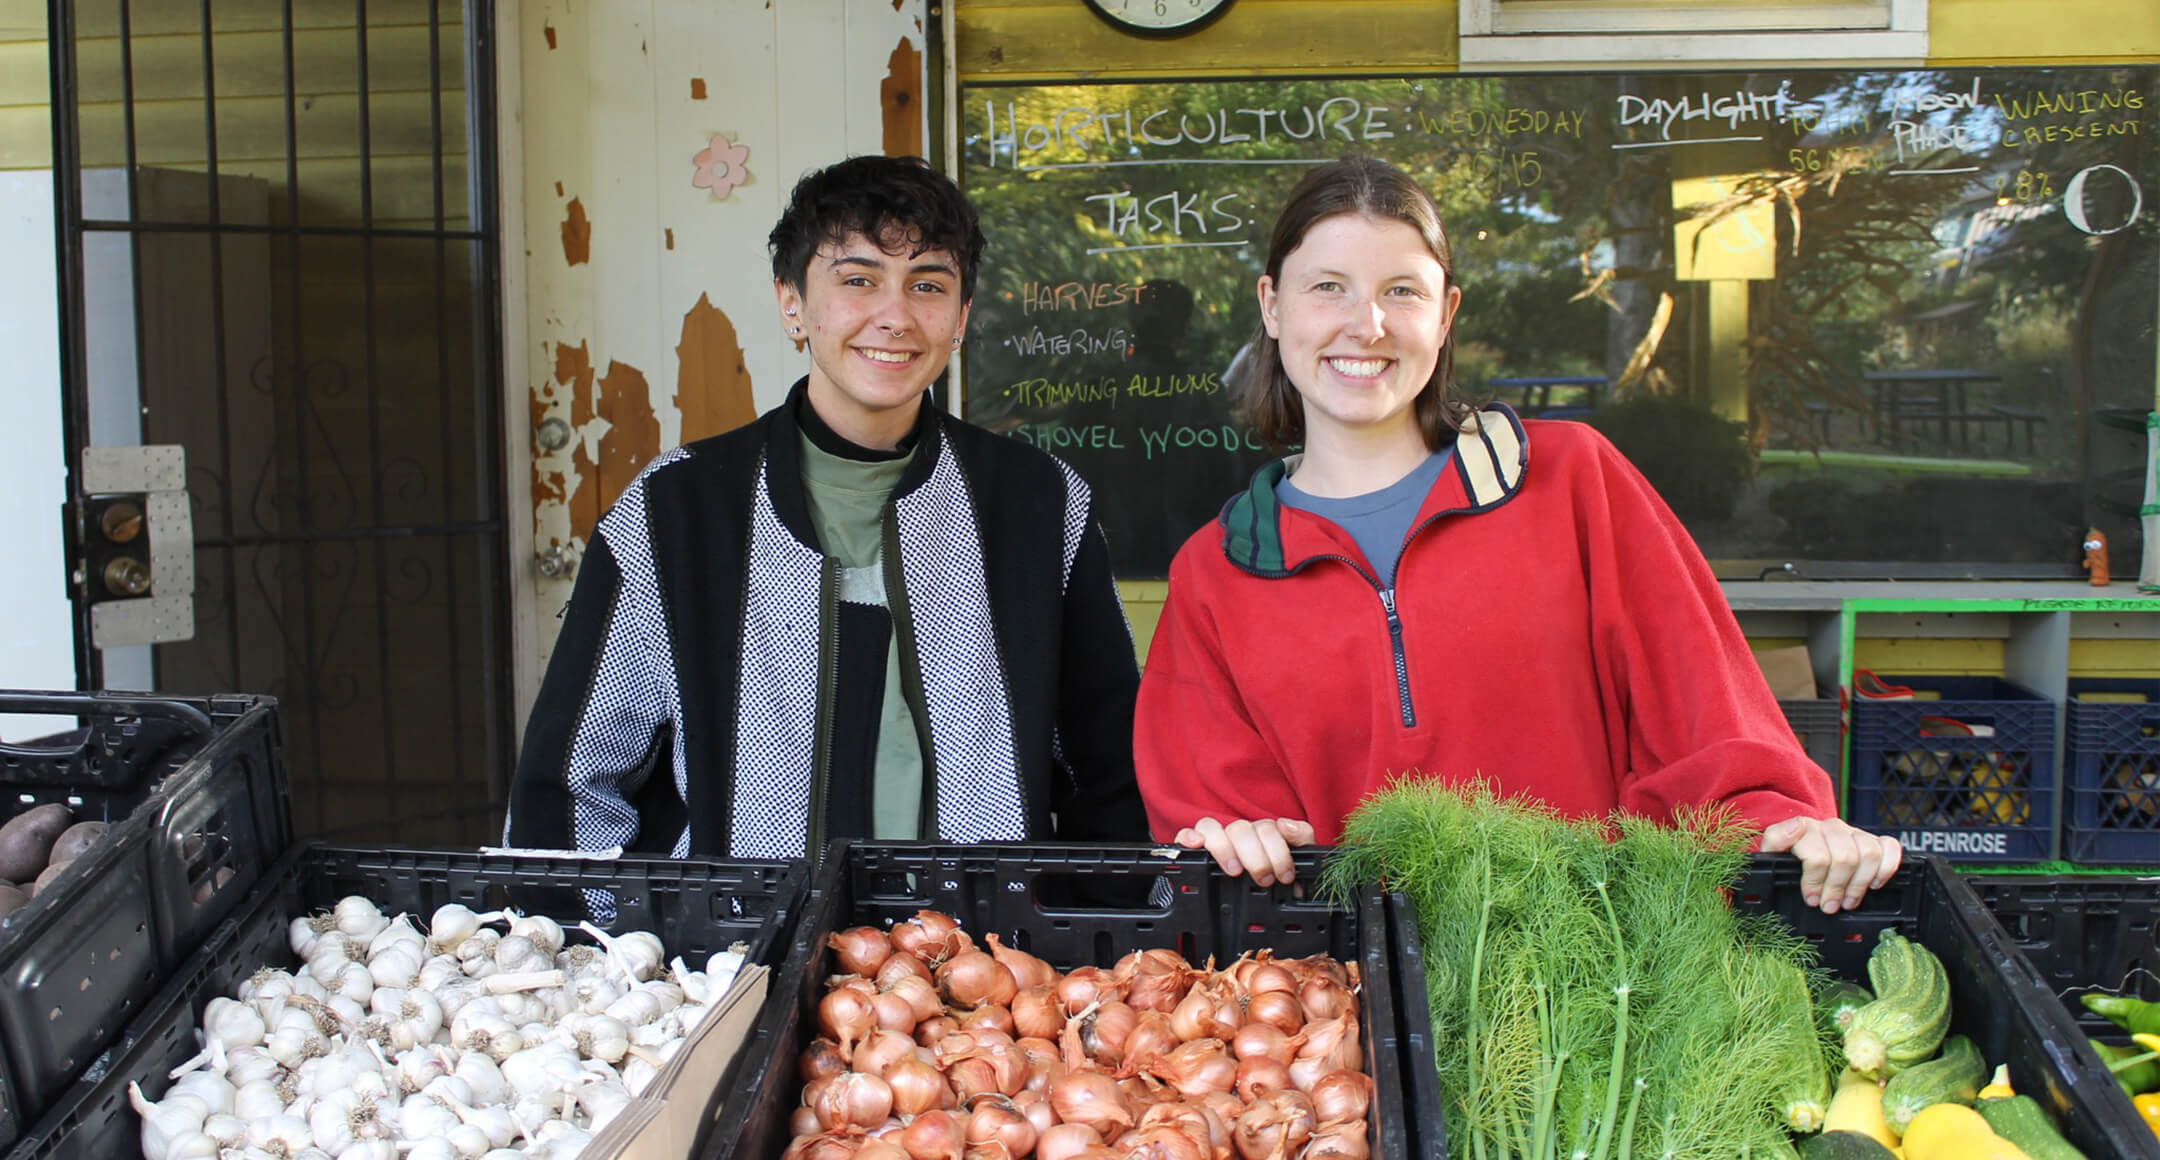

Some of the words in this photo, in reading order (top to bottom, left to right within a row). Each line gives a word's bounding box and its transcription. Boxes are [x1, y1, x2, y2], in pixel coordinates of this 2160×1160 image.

[1995, 90, 2144, 121] WANING
[986, 96, 1412, 170] HORTICULTURE:
[1418, 107, 1587, 138] WEDNESDAY
[2002, 120, 2139, 148] CRESCENT
[1789, 148, 1821, 173] 56
[1086, 191, 1256, 235] TASKS:
[1012, 378, 1117, 409] TRIMMING
[1017, 424, 1125, 454] SHOVEL
[1899, 831, 2007, 854] ALPENROSE
